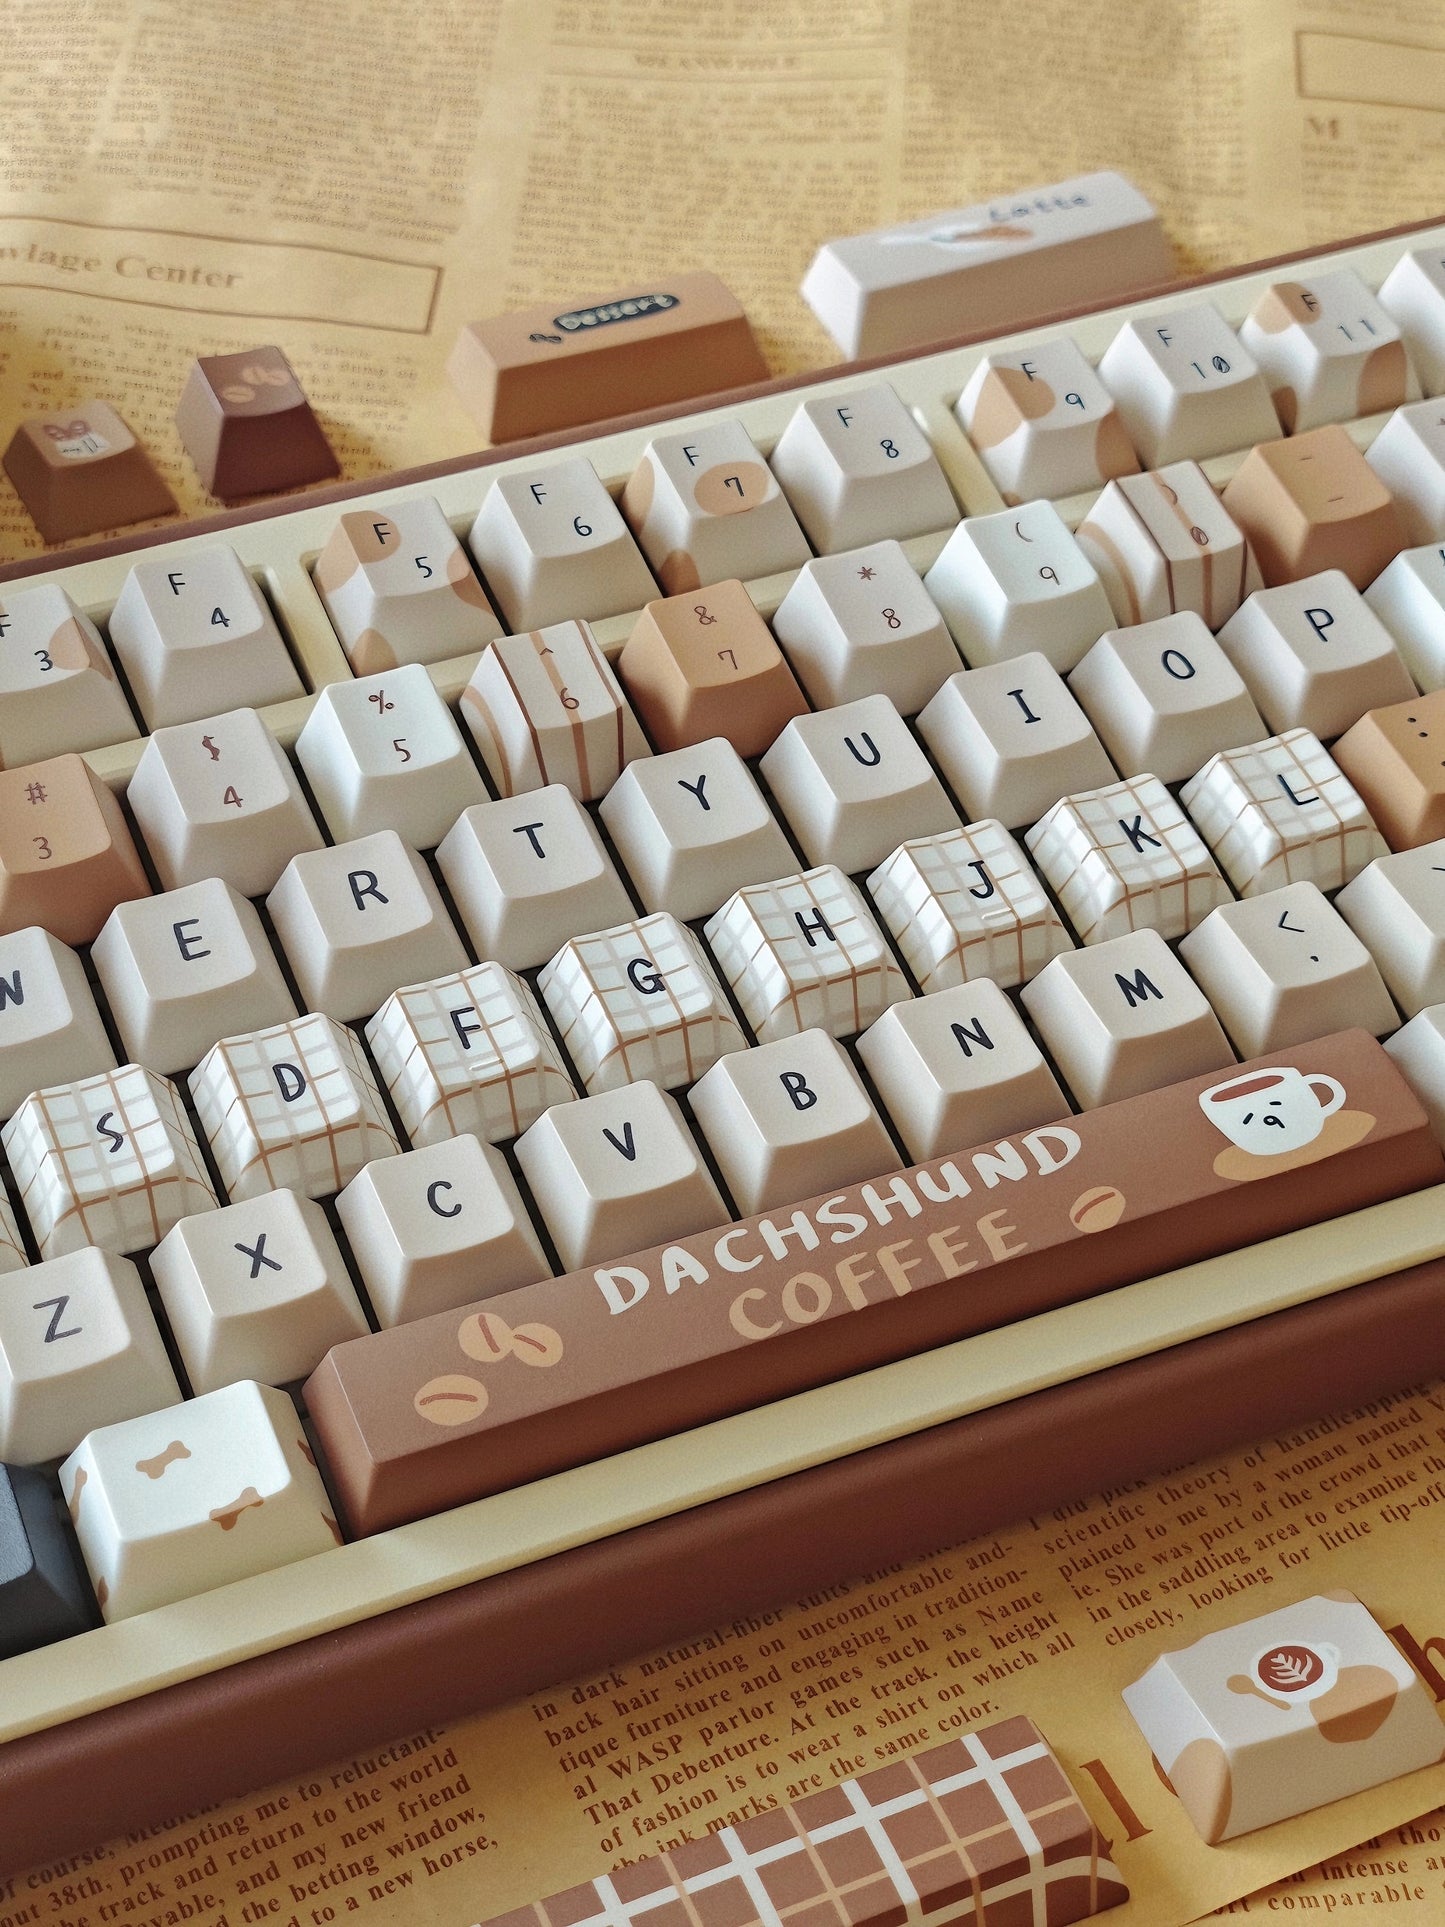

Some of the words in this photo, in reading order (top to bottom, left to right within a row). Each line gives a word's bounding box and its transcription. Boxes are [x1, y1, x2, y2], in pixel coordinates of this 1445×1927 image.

[115, 254, 244, 289] Center
[1301, 293, 1319, 312] F
[1337, 319, 1376, 342] 11
[1156, 328, 1174, 347] F
[1191, 355, 1231, 379] 10
[1021, 361, 1037, 382] F
[1065, 393, 1086, 410] 9
[836, 407, 854, 428] F
[880, 439, 899, 458] 8
[682, 445, 700, 467] F
[724, 476, 745, 498] 7
[530, 483, 548, 505] F
[573, 516, 593, 537] 6
[372, 522, 391, 545] F
[415, 556, 433, 578] 5
[1039, 565, 1060, 586] 9
[168, 572, 186, 596] F
[211, 607, 231, 628] 4
[881, 607, 901, 629] 8
[694, 605, 717, 625] &
[717, 649, 739, 671] 7
[1303, 607, 1335, 642] P
[34, 649, 53, 672] 3
[1160, 649, 1196, 680] O
[559, 686, 580, 711] 6
[1006, 688, 1042, 724] I
[368, 689, 394, 715] %
[392, 738, 411, 763] 5
[844, 731, 882, 767] U
[24, 781, 48, 805] #
[223, 785, 244, 808] 4
[678, 774, 711, 811] Y
[1277, 774, 1320, 806] L
[31, 836, 52, 860] 3
[512, 821, 546, 859] T
[1118, 814, 1162, 853] K
[348, 869, 390, 911] R
[967, 860, 995, 900] J
[173, 918, 212, 962] E
[794, 906, 837, 947] H
[626, 958, 667, 995] G
[1114, 967, 1165, 1009] M
[449, 1006, 482, 1050] F
[950, 1016, 995, 1058] N
[271, 1062, 307, 1103] D
[780, 1071, 818, 1112] B
[96, 1111, 124, 1154] S
[601, 1121, 637, 1162] V
[427, 1179, 463, 1218] C
[593, 1125, 1083, 1316] DACHSHUND
[233, 1232, 283, 1280] X
[728, 1208, 1029, 1341] COFFEE
[32, 1294, 83, 1344] Z
[1044, 1501, 1146, 1554] scientific
[1156, 1465, 1232, 1506] theory
[1243, 1446, 1267, 1469] of
[1274, 1382, 1432, 1454] handicapping
[1058, 1533, 1137, 1583] plained
[1145, 1522, 1167, 1541] to
[1177, 1503, 1208, 1527] me
[1213, 1488, 1243, 1508] by
[1254, 1479, 1267, 1494] a
[1274, 1443, 1349, 1483] woman
[1355, 1406, 1424, 1447] named
[1104, 1558, 1147, 1588] She
[1151, 1539, 1193, 1567] was
[1198, 1515, 1246, 1551] port
[1251, 1499, 1274, 1523] of
[1278, 1485, 1313, 1511] the
[1319, 1451, 1383, 1494] crowd
[1386, 1432, 1431, 1462] that
[1086, 1606, 1112, 1624] in
[1117, 1587, 1153, 1612] the
[1158, 1546, 1251, 1595] saddling
[1254, 1523, 1301, 1552] area
[1305, 1509, 1327, 1528] to
[1334, 1466, 1418, 1515] examine
[1105, 1607, 1184, 1648] closely,
[1188, 1565, 1274, 1611] looking
[1278, 1544, 1312, 1570] for
[1317, 1517, 1373, 1552] little
[531, 1703, 559, 1722] in
[571, 1671, 629, 1705] dark
[639, 1607, 784, 1678] natural-fiber
[544, 1710, 603, 1748] back
[612, 1686, 661, 1717] hair
[674, 1652, 749, 1692] sitting
[758, 1637, 787, 1658] on
[796, 1565, 954, 1642] uncomfortable
[965, 1541, 1013, 1571] and-
[558, 1736, 620, 1774] tique
[626, 1688, 734, 1742] furniture
[740, 1664, 783, 1695] and
[791, 1623, 891, 1674] engaging
[893, 1610, 918, 1632] in
[923, 1568, 1028, 1620] tradition-
[573, 1774, 598, 1800] al
[606, 1733, 685, 1781] WASP
[698, 1698, 776, 1747] parlor
[790, 1663, 864, 1709] games
[875, 1636, 930, 1669] such
[942, 1621, 968, 1643] as
[976, 1588, 1045, 1627] Name
[583, 1786, 644, 1826] That
[650, 1732, 780, 1795] Debenture.
[789, 1711, 817, 1736] At
[825, 1693, 863, 1720] the
[870, 1664, 938, 1701] track.
[945, 1643, 983, 1670] the
[989, 1609, 1061, 1650] height
[600, 1826, 624, 1853] of
[632, 1786, 719, 1837] fashion
[724, 1774, 748, 1794] is
[755, 1760, 780, 1780] to
[787, 1732, 841, 1764] wear
[853, 1723, 868, 1738] a
[875, 1694, 930, 1729] shirt
[937, 1682, 966, 1703] on
[972, 1649, 1039, 1688] which
[1046, 1631, 1076, 1659] all
[655, 1829, 695, 1854] ink
[705, 1793, 778, 1834] marks
[786, 1773, 824, 1799] are
[829, 1754, 867, 1778] the
[874, 1727, 930, 1760] same
[937, 1697, 1000, 1732] color.
[48, 1876, 113, 1912] 38th,
[119, 1814, 249, 1887] prompting
[255, 1796, 290, 1822] me
[297, 1782, 322, 1802] to
[330, 1727, 446, 1790] reluctant-
[98, 1881, 166, 1922] track
[174, 1855, 219, 1891] and
[226, 1821, 305, 1867] return
[312, 1807, 337, 1828] to
[344, 1786, 383, 1814] the
[389, 1746, 459, 1794] world
[235, 1859, 282, 1896] and
[292, 1841, 328, 1870] my
[339, 1817, 387, 1850] new
[396, 1772, 473, 1823] friend
[1397, 1824, 1445, 1845] tho
[27, 1845, 116, 1890] course,
[241, 1897, 282, 1924] the
[288, 1853, 380, 1903] betting
[386, 1806, 486, 1860] window,
[310, 1905, 336, 1926] to
[345, 1895, 360, 1911] a
[367, 1868, 415, 1902] new
[421, 1834, 499, 1876] horse,
[1318, 1859, 1409, 1881] intense
[1267, 1882, 1425, 1913] comparable
